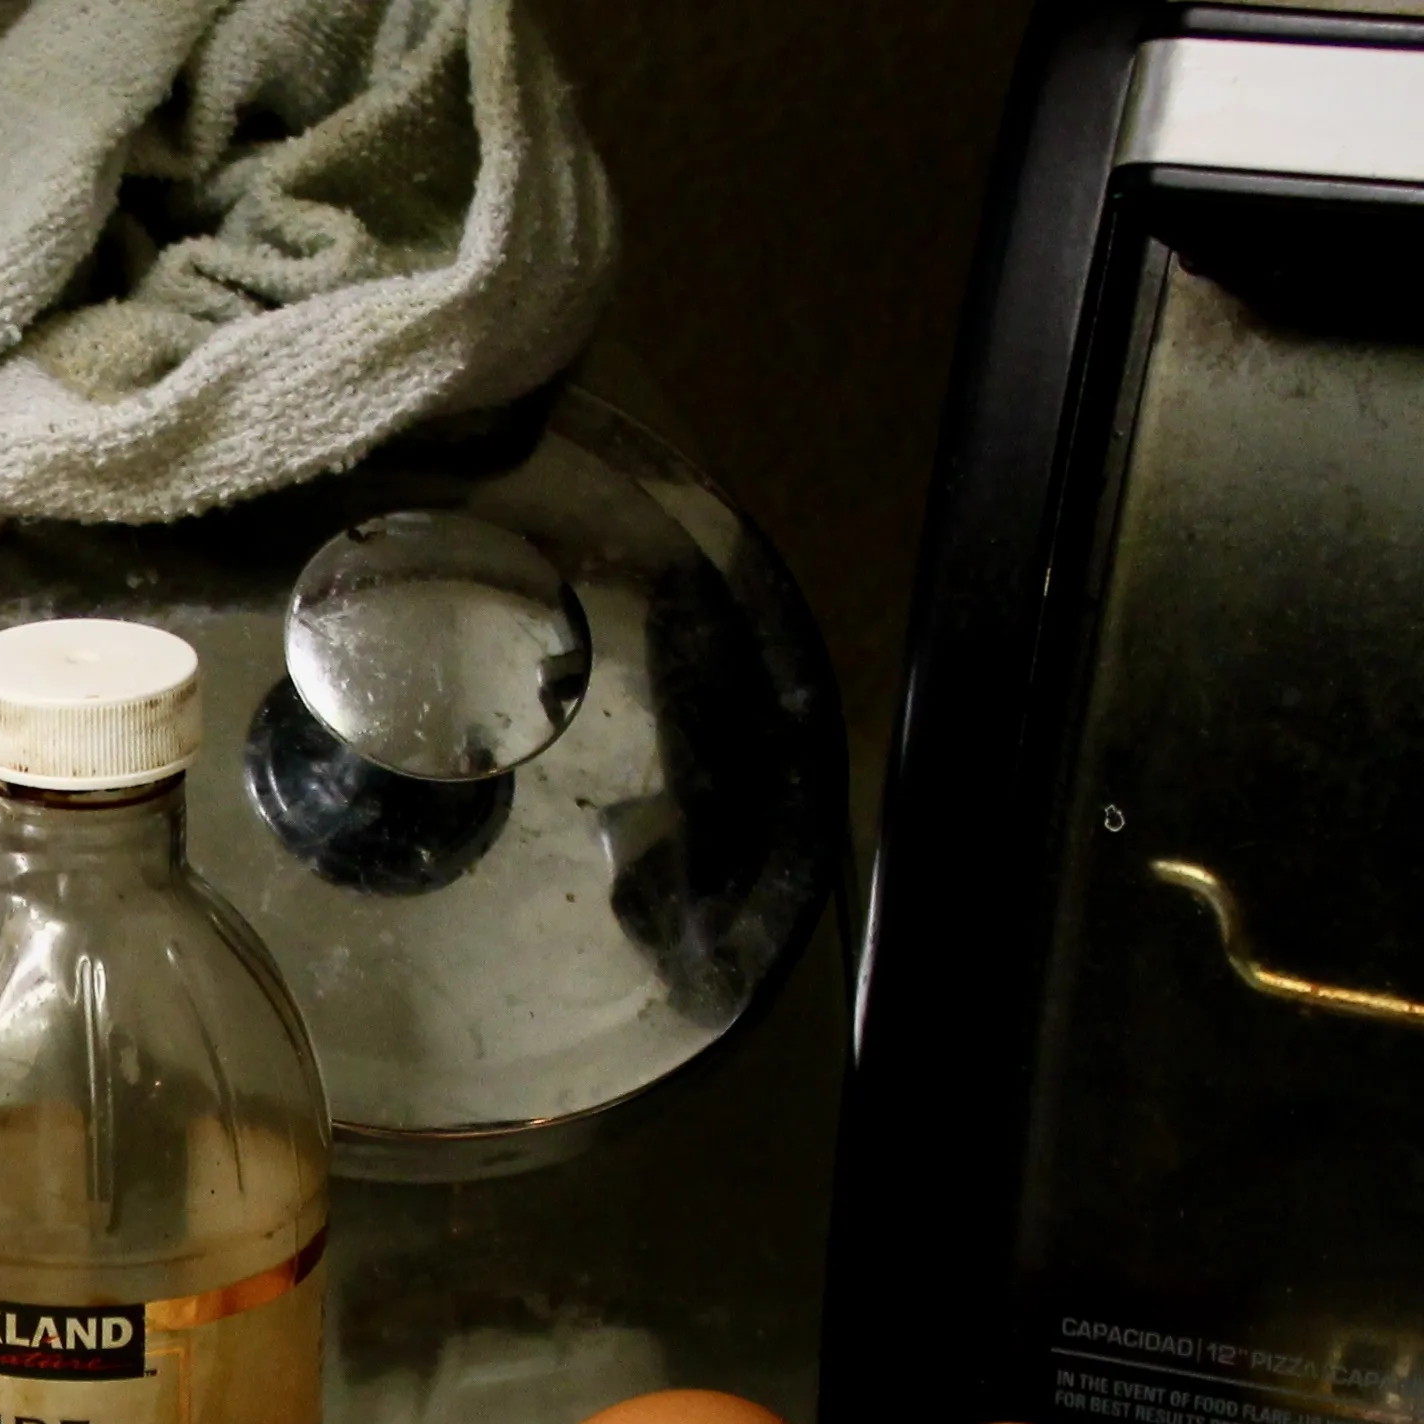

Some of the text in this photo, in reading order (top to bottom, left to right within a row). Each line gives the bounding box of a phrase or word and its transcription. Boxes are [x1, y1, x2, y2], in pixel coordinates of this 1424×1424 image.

[1061, 1316, 1194, 1357] CAPACIDAD
[1054, 1389, 1087, 1411] FOR
[1089, 1396, 1132, 1419] BEST
[1056, 1368, 1075, 1388] IN
[1079, 1372, 1109, 1395] THE
[1113, 1380, 1166, 1405] EVENT
[1170, 1390, 1191, 1409] OF
[1193, 1394, 1239, 1418] FOOD
